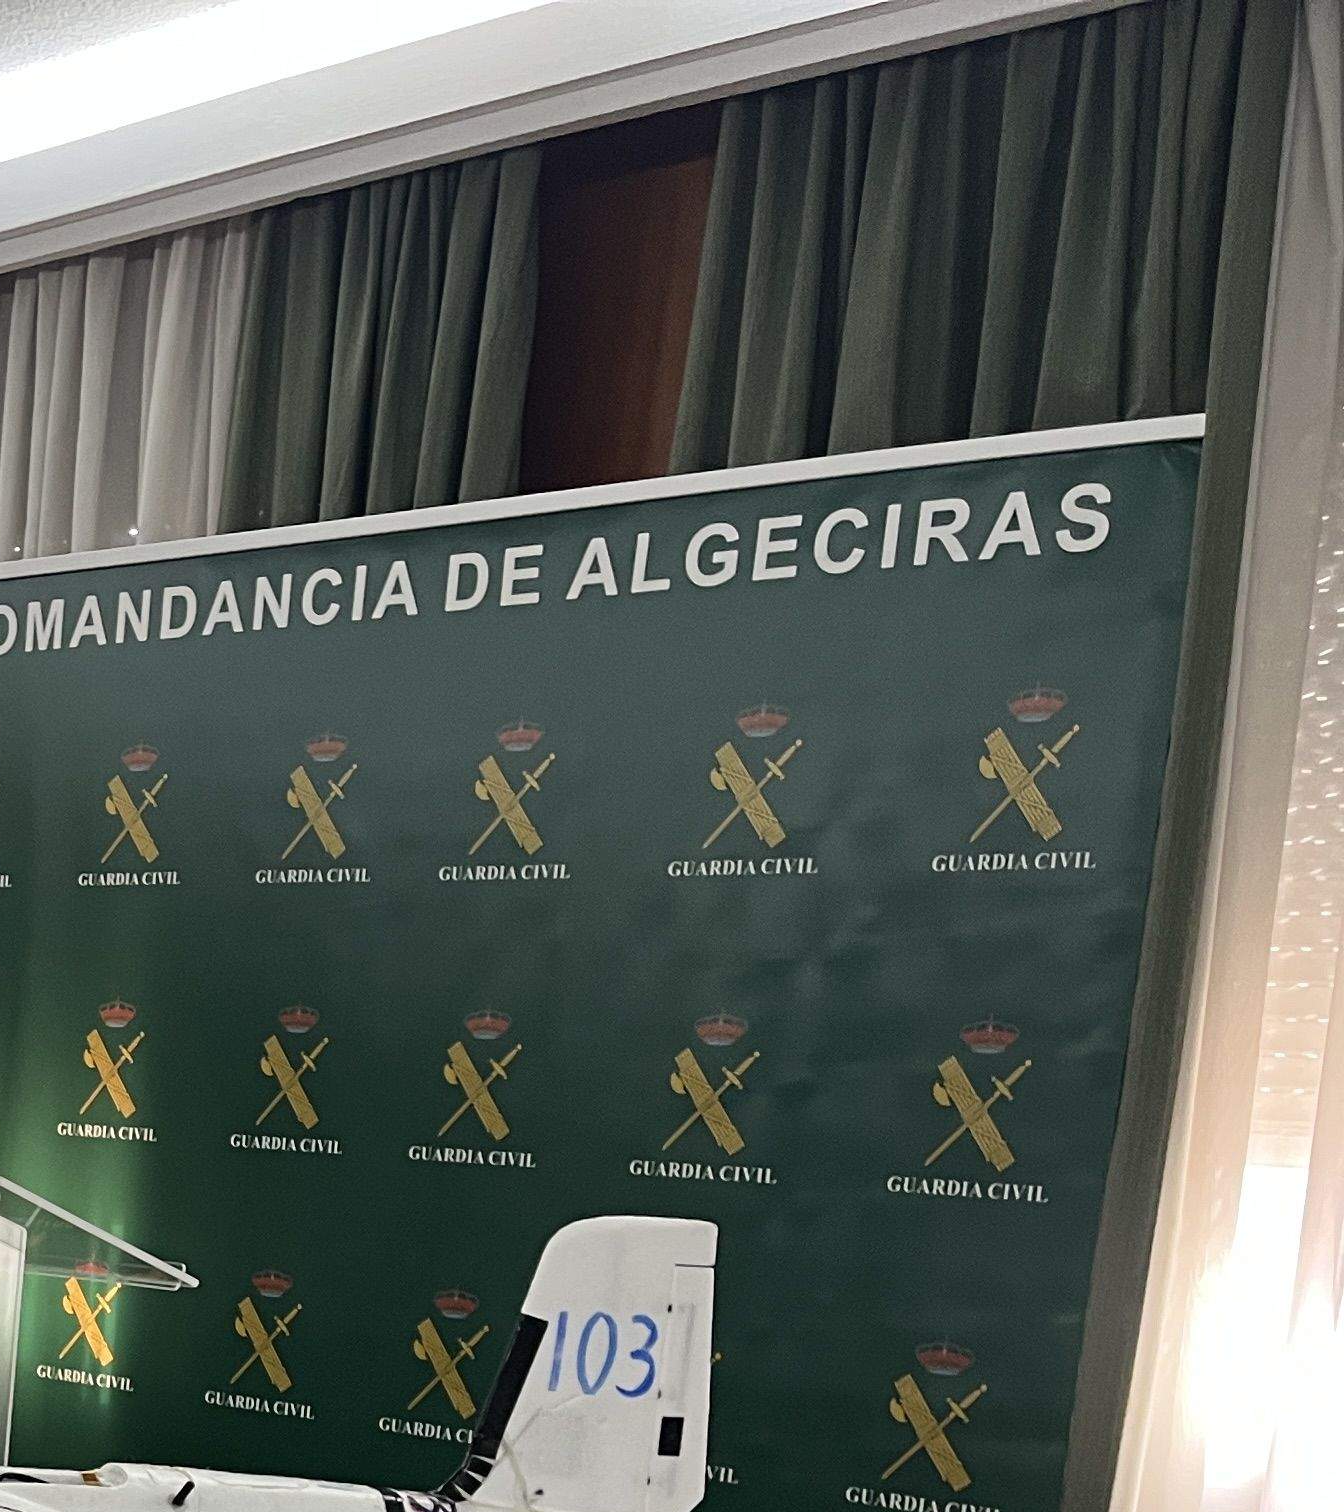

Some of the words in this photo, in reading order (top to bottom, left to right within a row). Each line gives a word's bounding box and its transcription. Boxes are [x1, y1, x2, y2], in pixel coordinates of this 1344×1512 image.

[444, 544, 544, 612] DE
[565, 482, 1112, 600] ALGECIRAS
[438, 865, 517, 881] GUARDIA
[520, 863, 571, 880] CIVIL
[667, 859, 756, 877] GUARDIA
[760, 857, 818, 875] CIVIL
[931, 853, 1028, 872] GUARDIA
[1034, 851, 1096, 870] CIVIL
[77, 872, 139, 887] GUARDIA
[141, 871, 181, 886] CIVIL
[255, 869, 324, 884] GUARDIA
[326, 867, 371, 883] CIVIL
[56, 1122, 116, 1139] GUARDIA
[118, 1126, 157, 1142] CIVIL
[230, 1133, 297, 1152] GUARDIA
[299, 1138, 343, 1155] CIVIL
[408, 1145, 484, 1165] GUARDIA
[488, 1150, 536, 1168] CIVIL
[629, 1159, 715, 1180] GUARDIA
[719, 1165, 777, 1184] CIVIL
[886, 1175, 982, 1199] GUARDIA
[987, 1182, 1049, 1203] CIVIL
[548, 1311, 658, 1398] 103
[36, 1364, 95, 1386] GUARDIA
[95, 1373, 134, 1391] CIVIL
[204, 1390, 270, 1413] GUARDIA
[273, 1400, 315, 1420] CIVIL
[378, 1417, 452, 1441] GUARDIA
